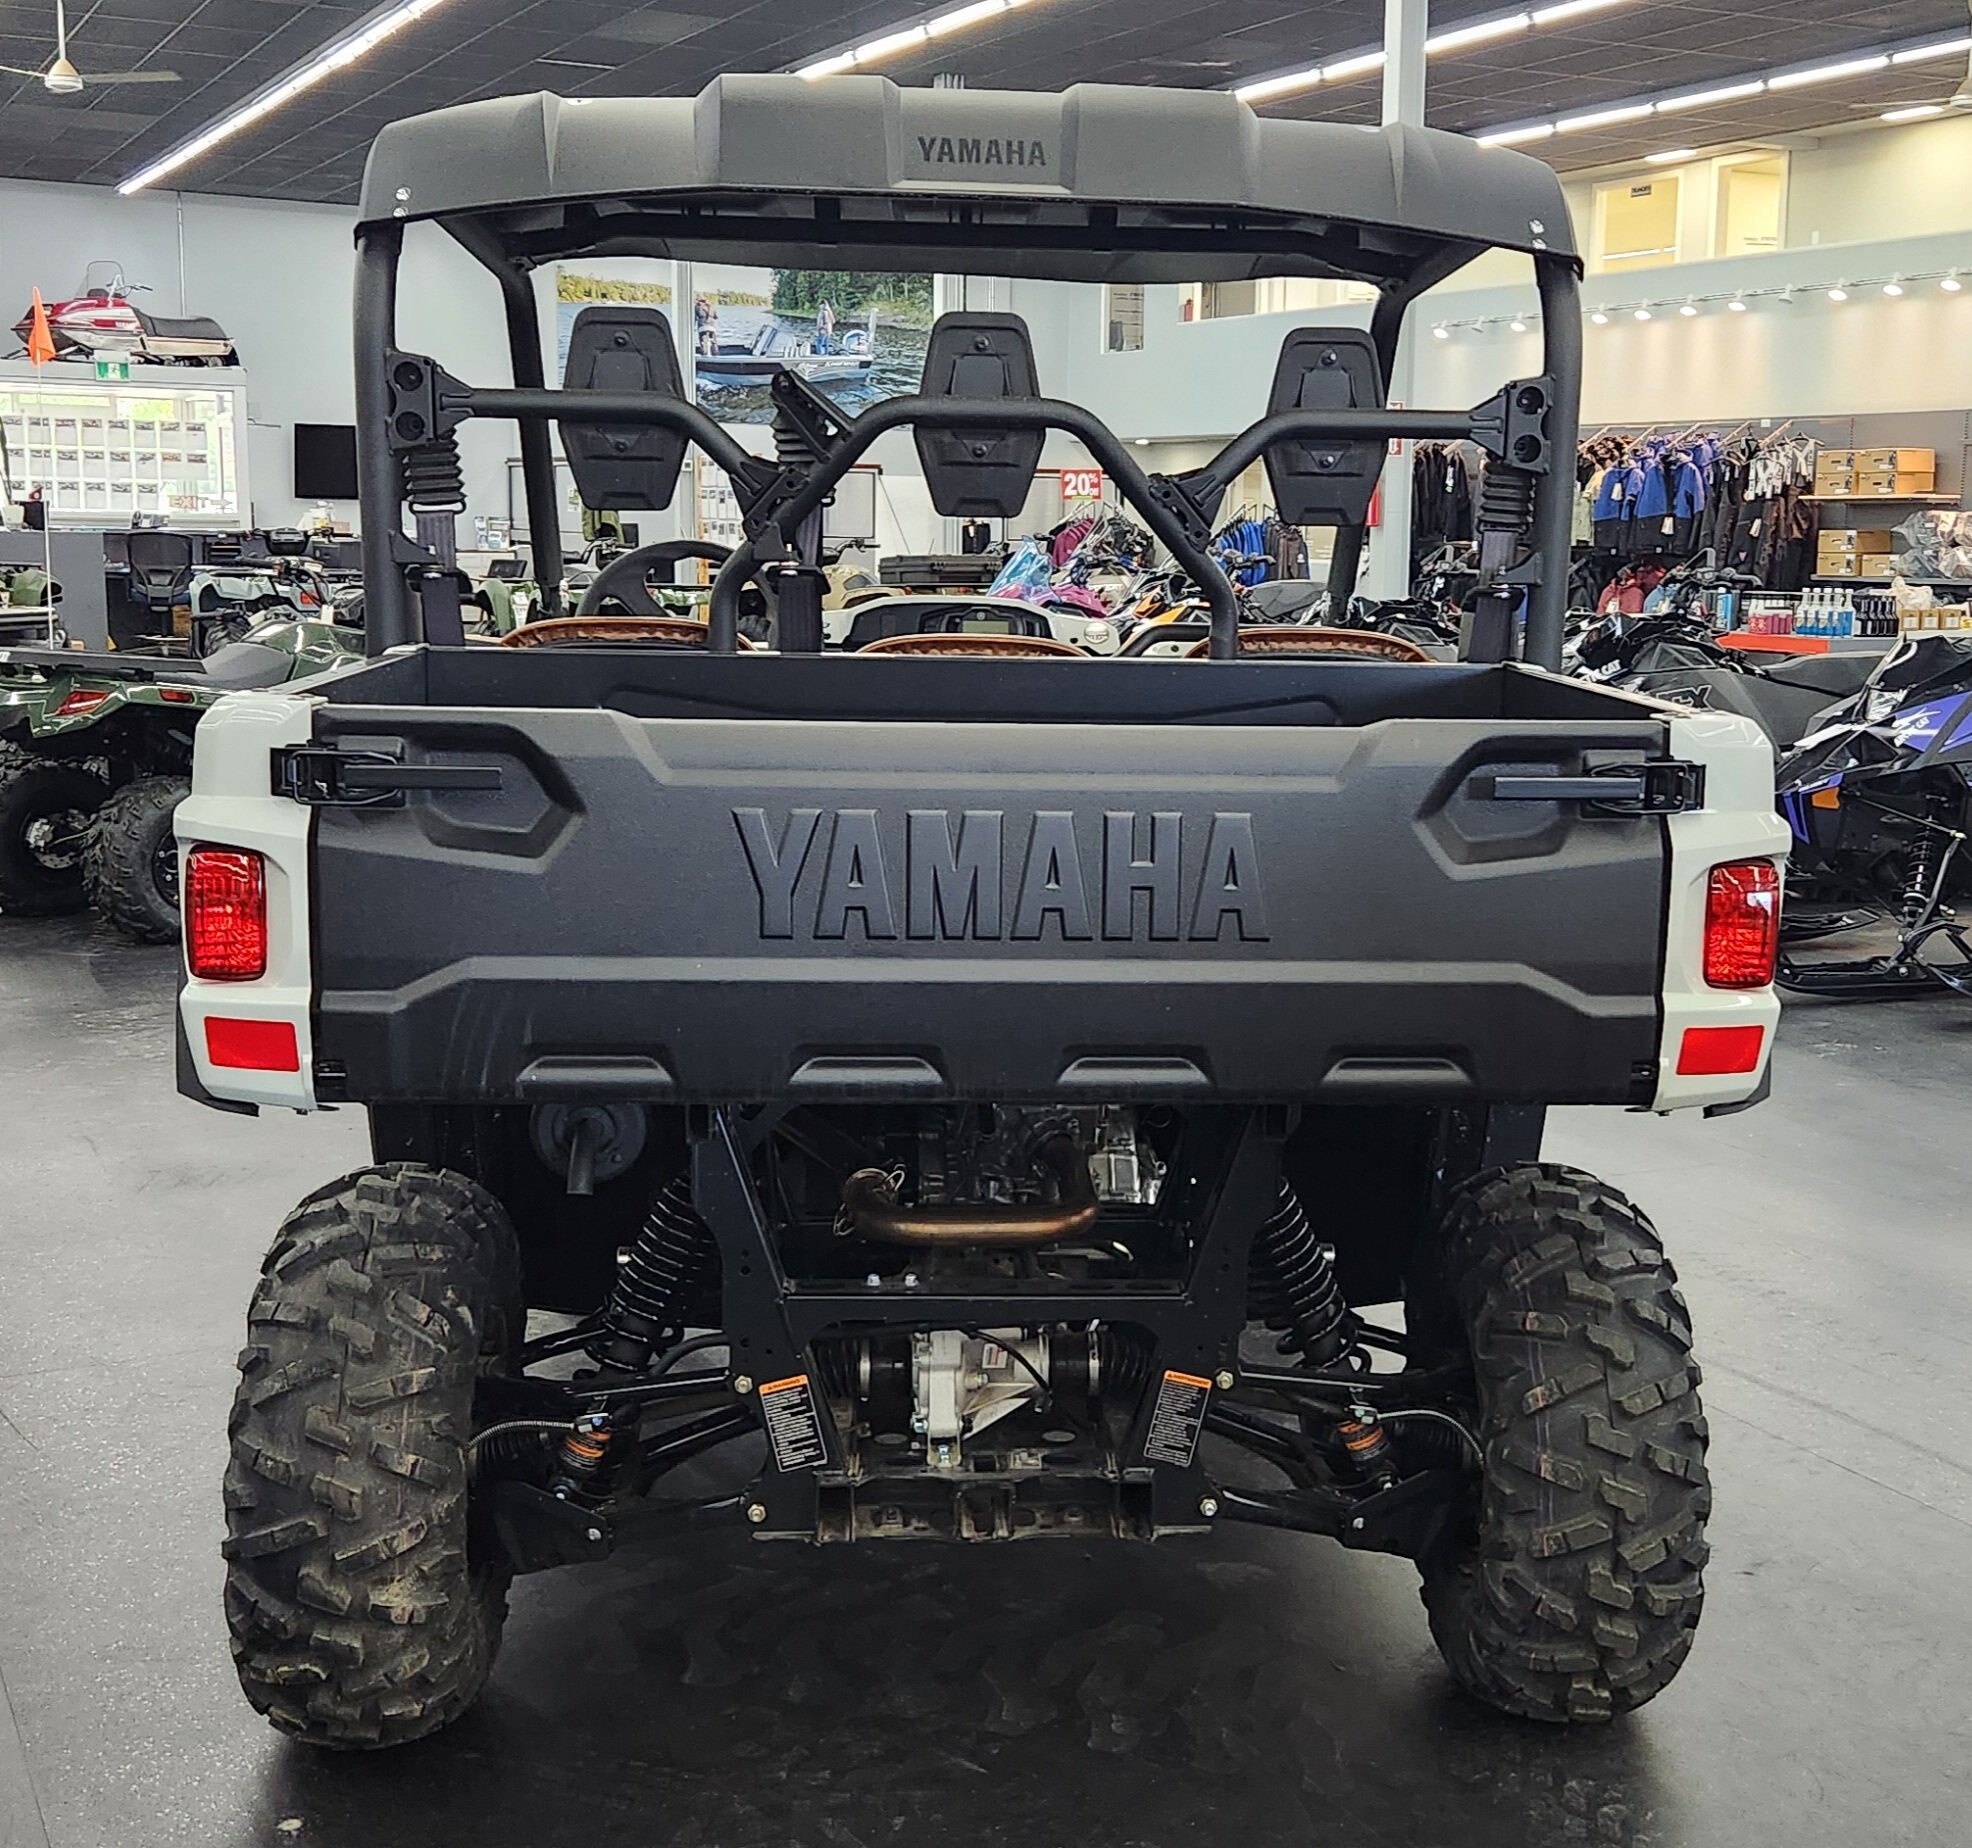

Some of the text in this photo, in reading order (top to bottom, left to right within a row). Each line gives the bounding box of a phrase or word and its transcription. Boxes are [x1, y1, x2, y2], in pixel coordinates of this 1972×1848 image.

[917, 136, 1047, 166] YAMAHA
[168, 495, 209, 511] EXIT
[1601, 659, 1622, 676] CAT
[731, 807, 1270, 942] YAMAHA
